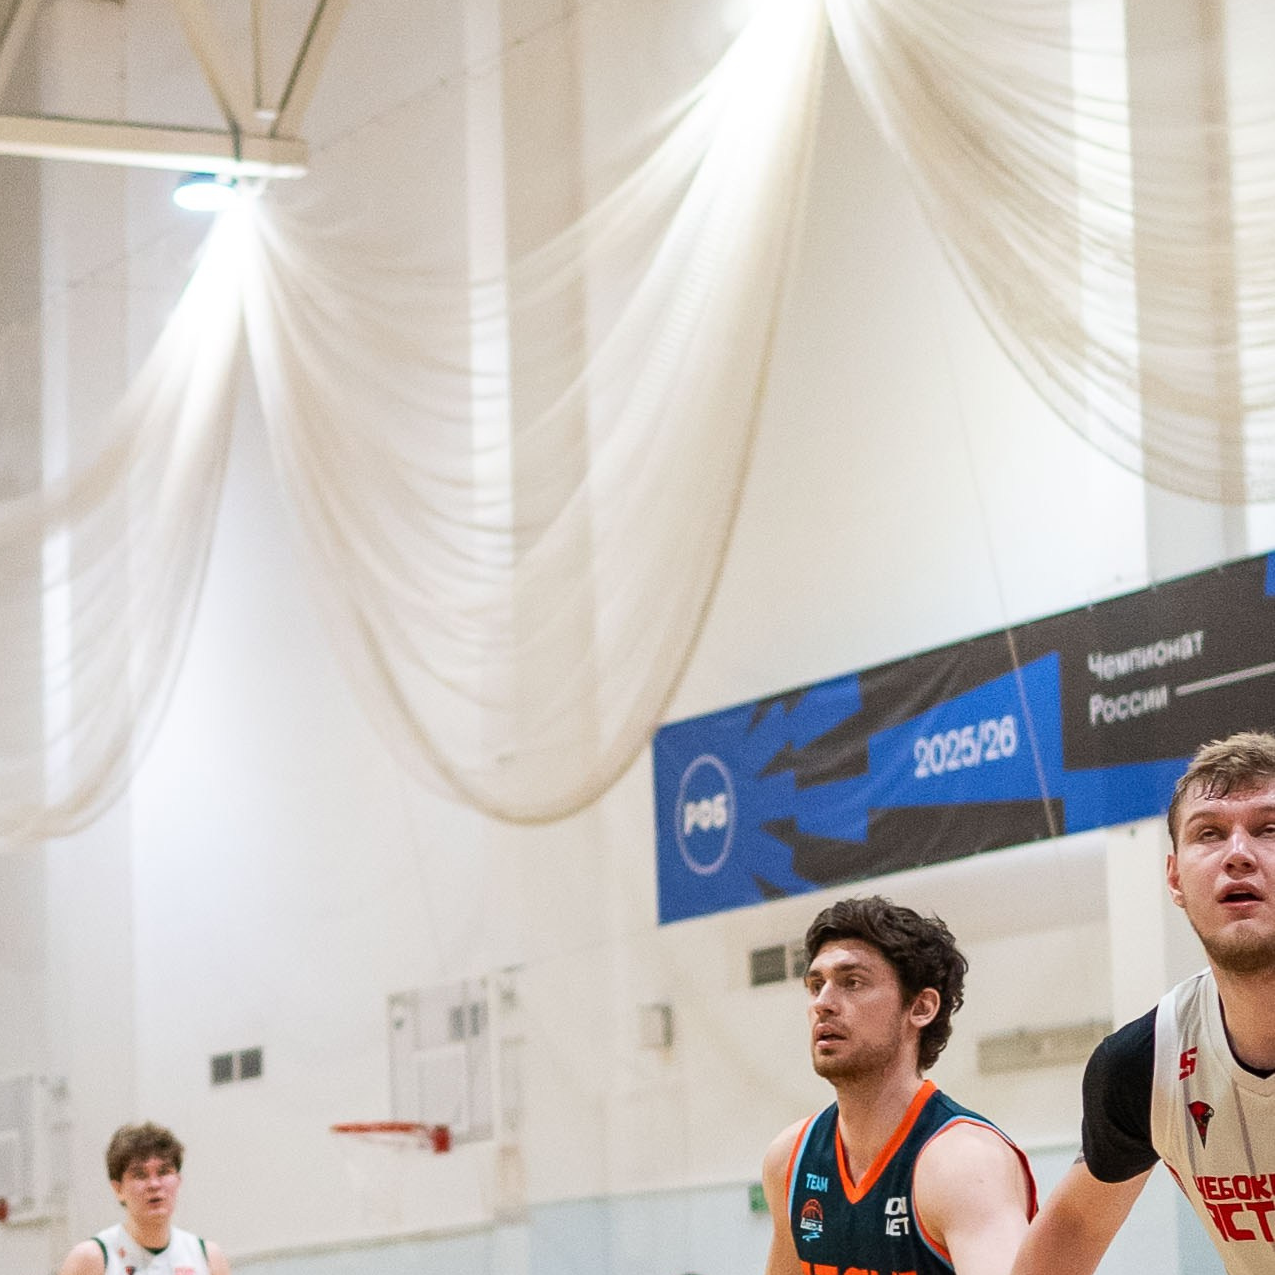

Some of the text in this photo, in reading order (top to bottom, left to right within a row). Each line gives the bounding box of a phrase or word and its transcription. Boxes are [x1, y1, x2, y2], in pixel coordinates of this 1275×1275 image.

[1088, 630, 1204, 680] Чемпионат
[1089, 685, 1168, 727] России
[1196, 1174, 1275, 1200] ЧЕБОК
